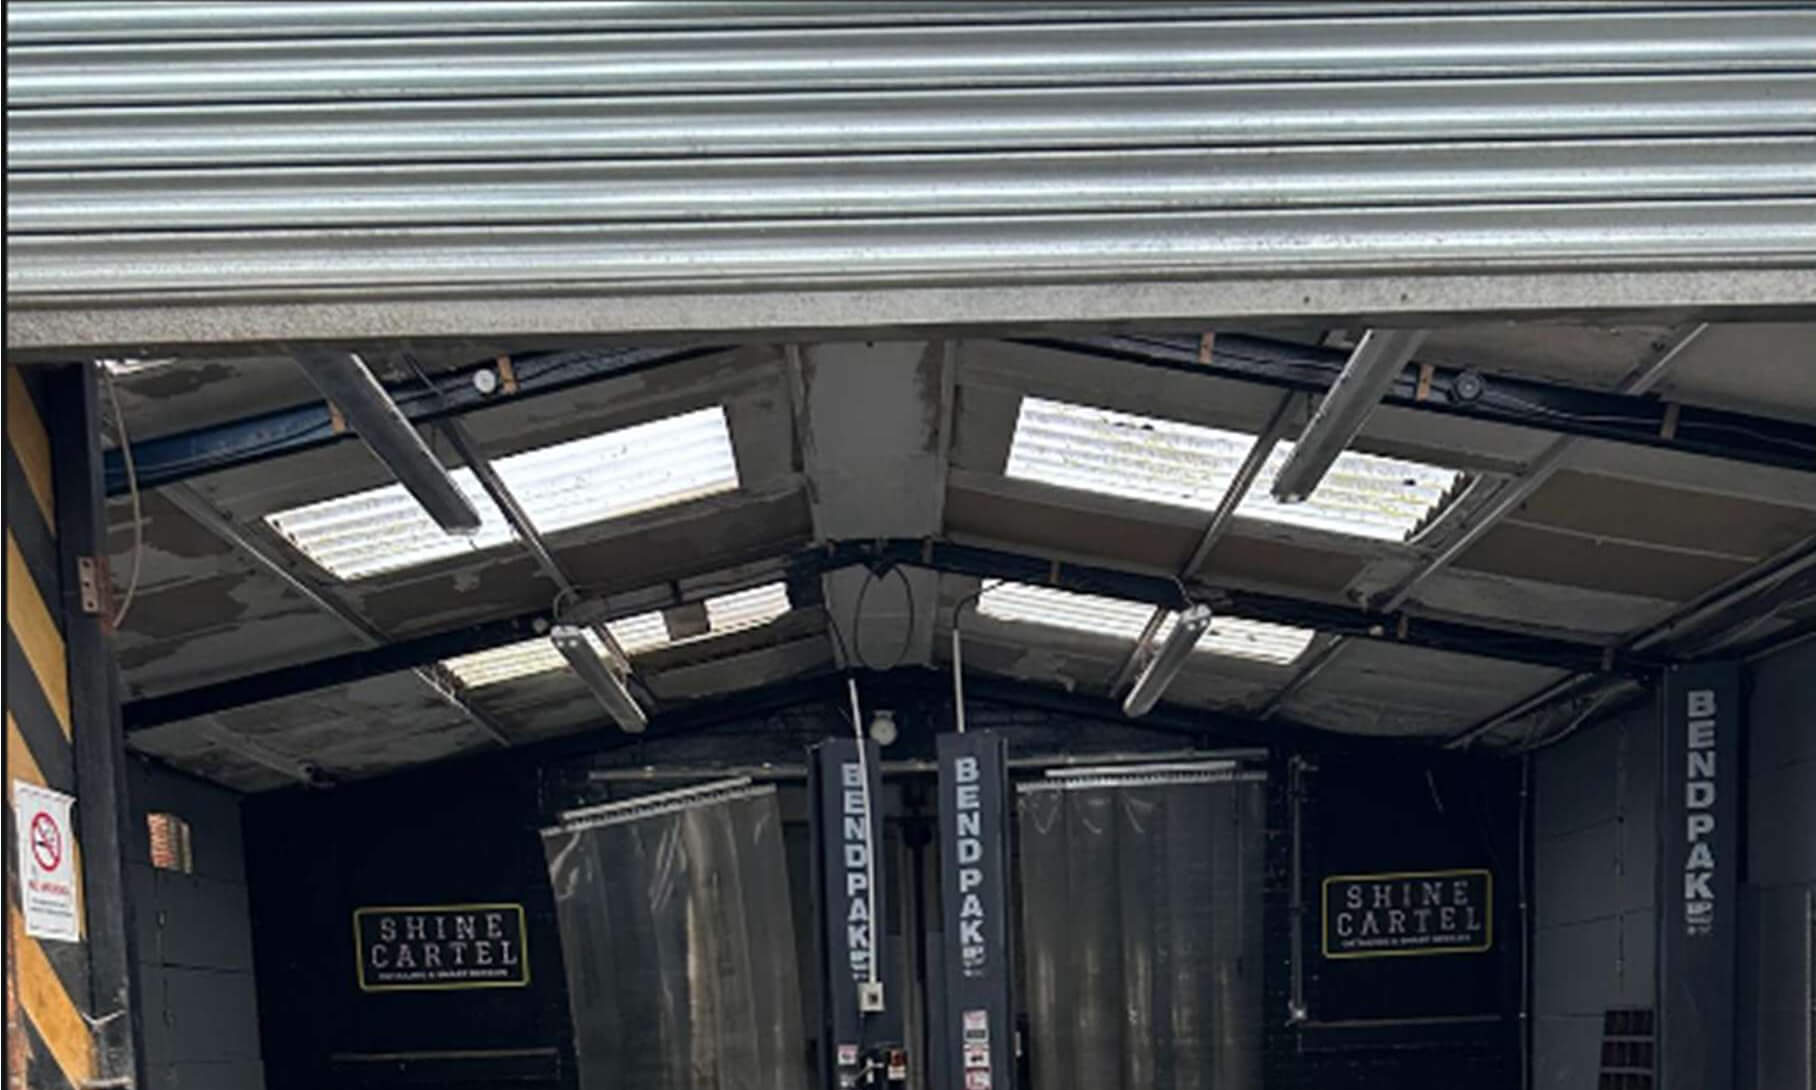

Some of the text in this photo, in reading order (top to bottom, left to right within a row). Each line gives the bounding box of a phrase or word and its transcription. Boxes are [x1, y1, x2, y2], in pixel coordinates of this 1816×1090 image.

[1685, 689, 1716, 899] BENDPAK
[841, 763, 870, 948] BENDPAK
[955, 757, 983, 945] BENDPAK
[1346, 880, 1469, 909] SHINE
[380, 913, 503, 941] SHINE
[1336, 906, 1481, 936] CARTEL
[370, 940, 518, 968] CARTEL
